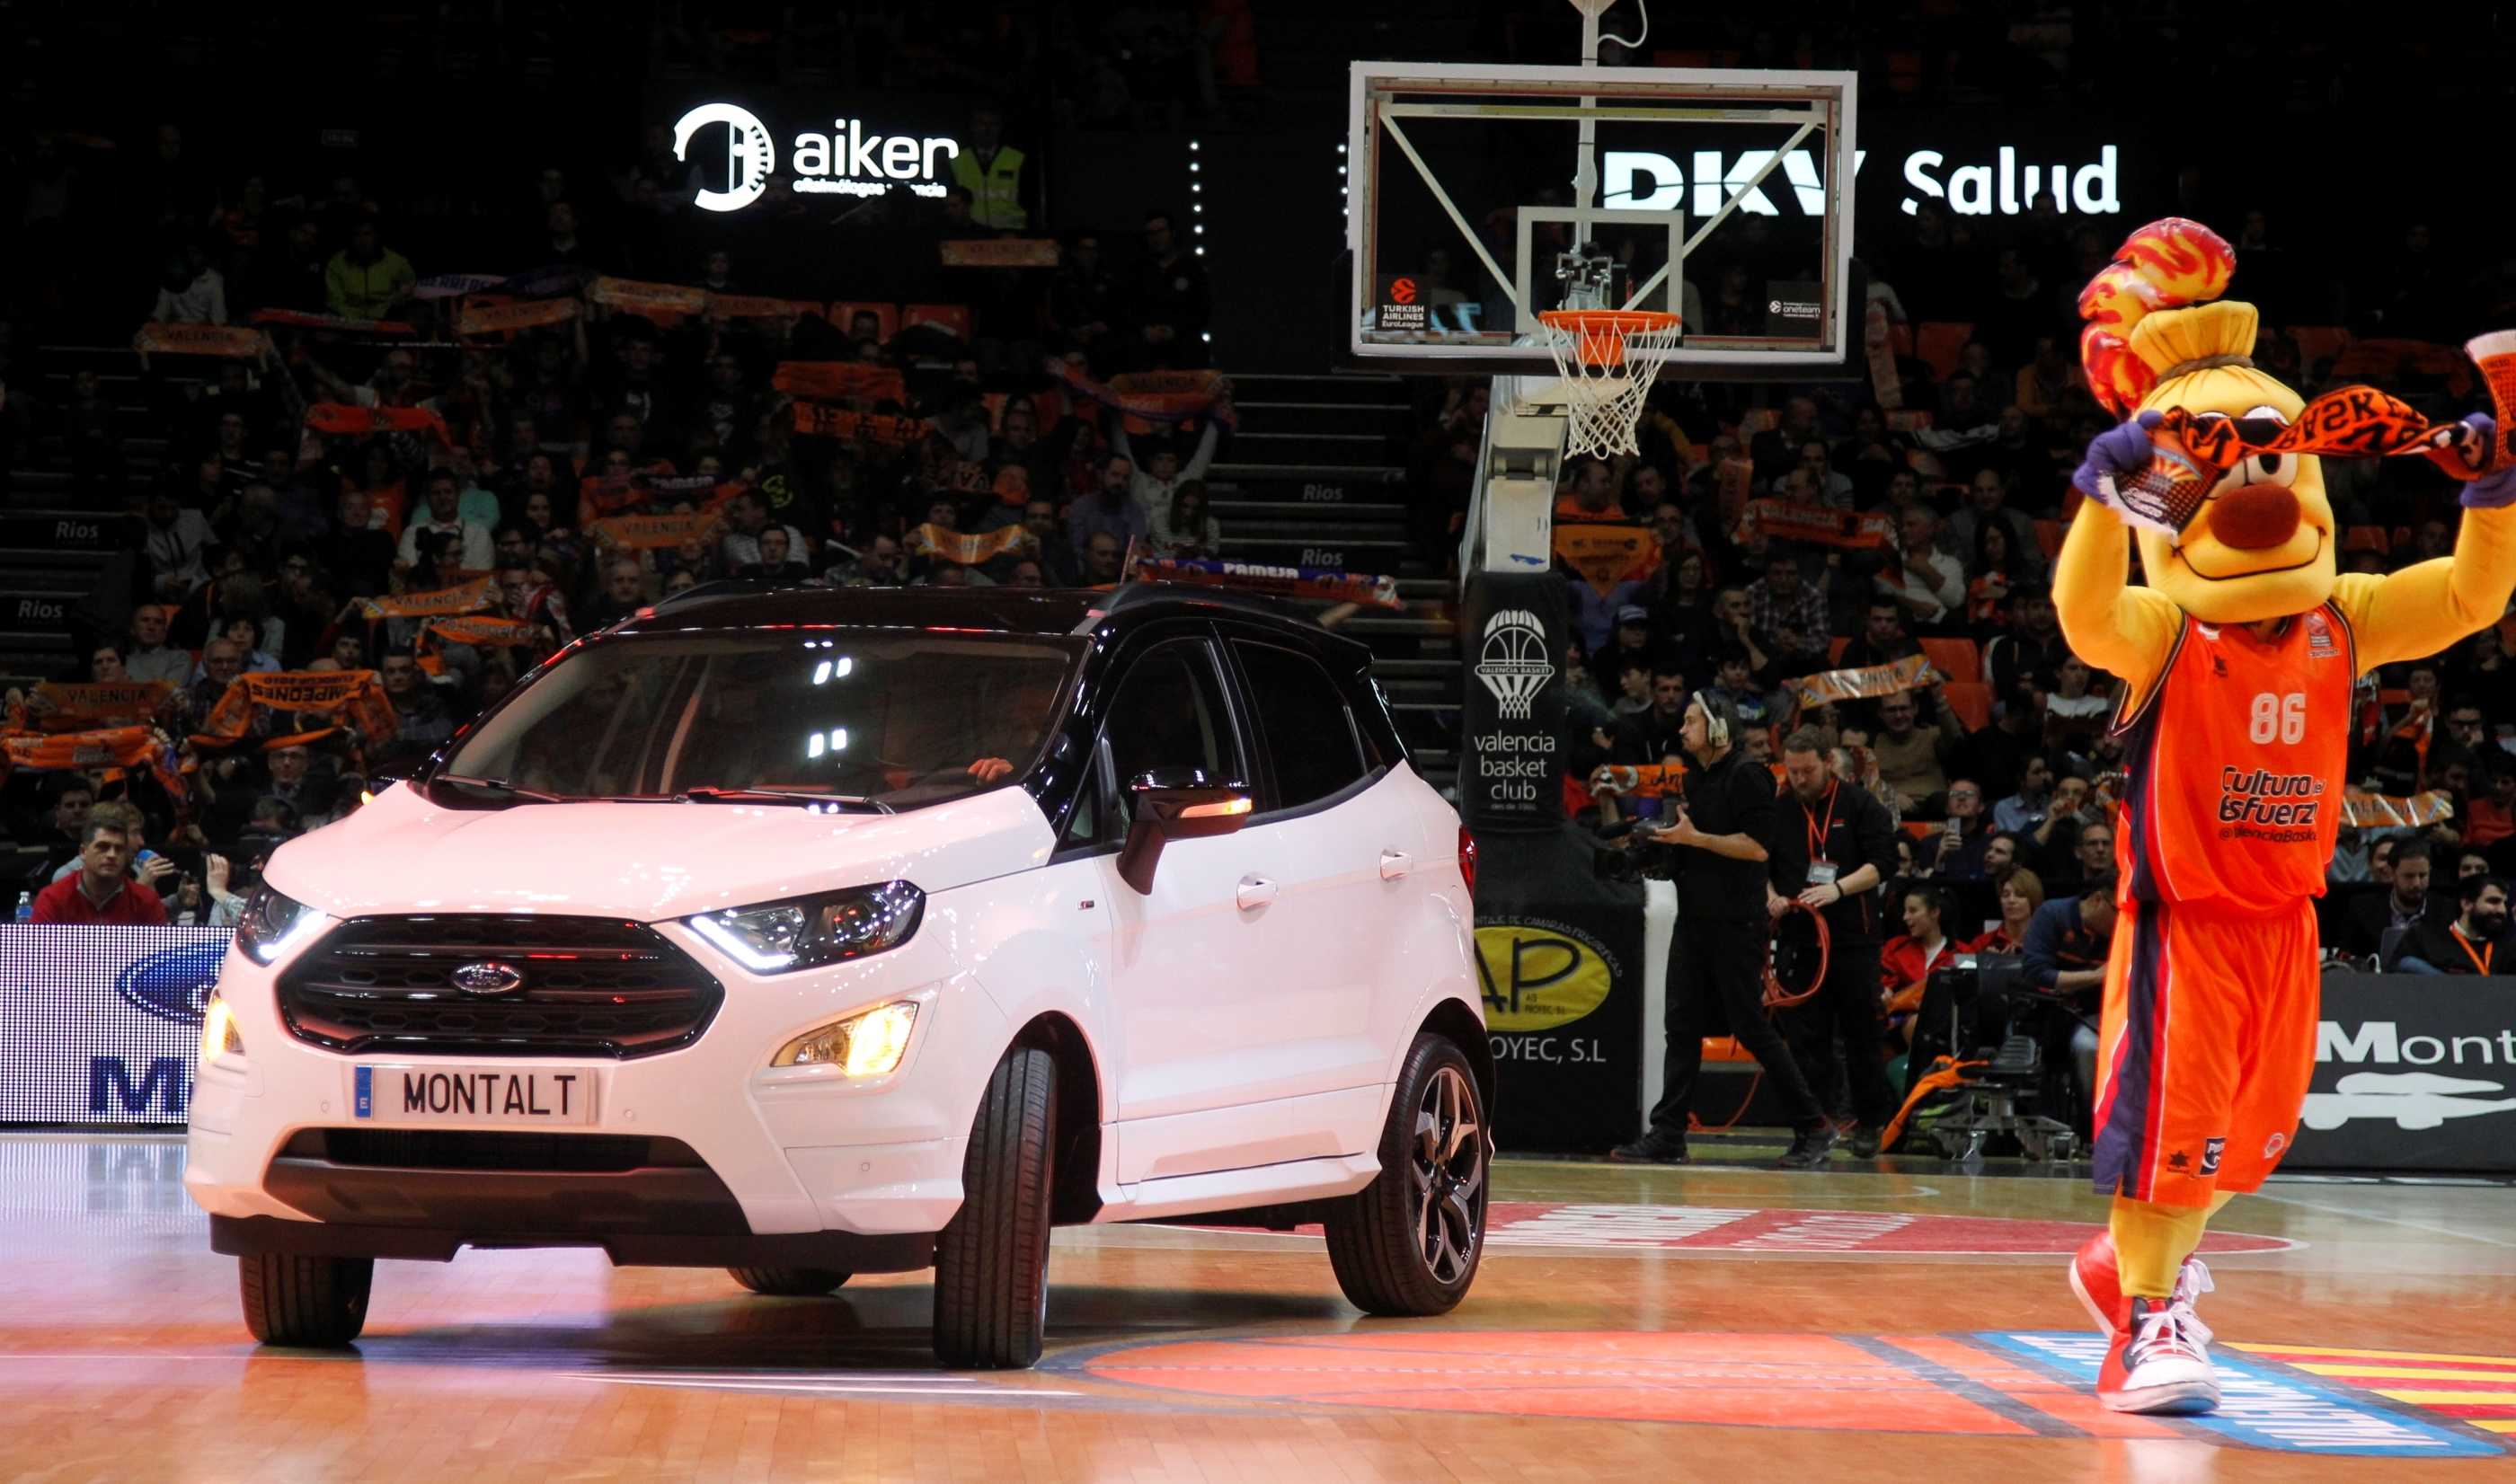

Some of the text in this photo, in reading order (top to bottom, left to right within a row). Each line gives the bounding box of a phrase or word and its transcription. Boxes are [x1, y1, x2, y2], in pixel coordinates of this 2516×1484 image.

[1604, 145, 2121, 216] DKV Salud
[1383, 313, 1424, 321] AIRLINES
[1302, 483, 1344, 501] Rios
[56, 520, 100, 539] Rios
[1301, 548, 1344, 566] Rios
[18, 599, 64, 619] Rios
[2249, 693, 2307, 746] 86
[1475, 729, 1555, 753] valencia
[1481, 755, 1547, 777] basket
[1491, 779, 1537, 800] club
[2221, 766, 2314, 797] Cultura
[2219, 794, 2320, 826] Esfuerz
[1488, 1037, 1563, 1064] OYEC,
[403, 1073, 577, 1117] MONTALT
